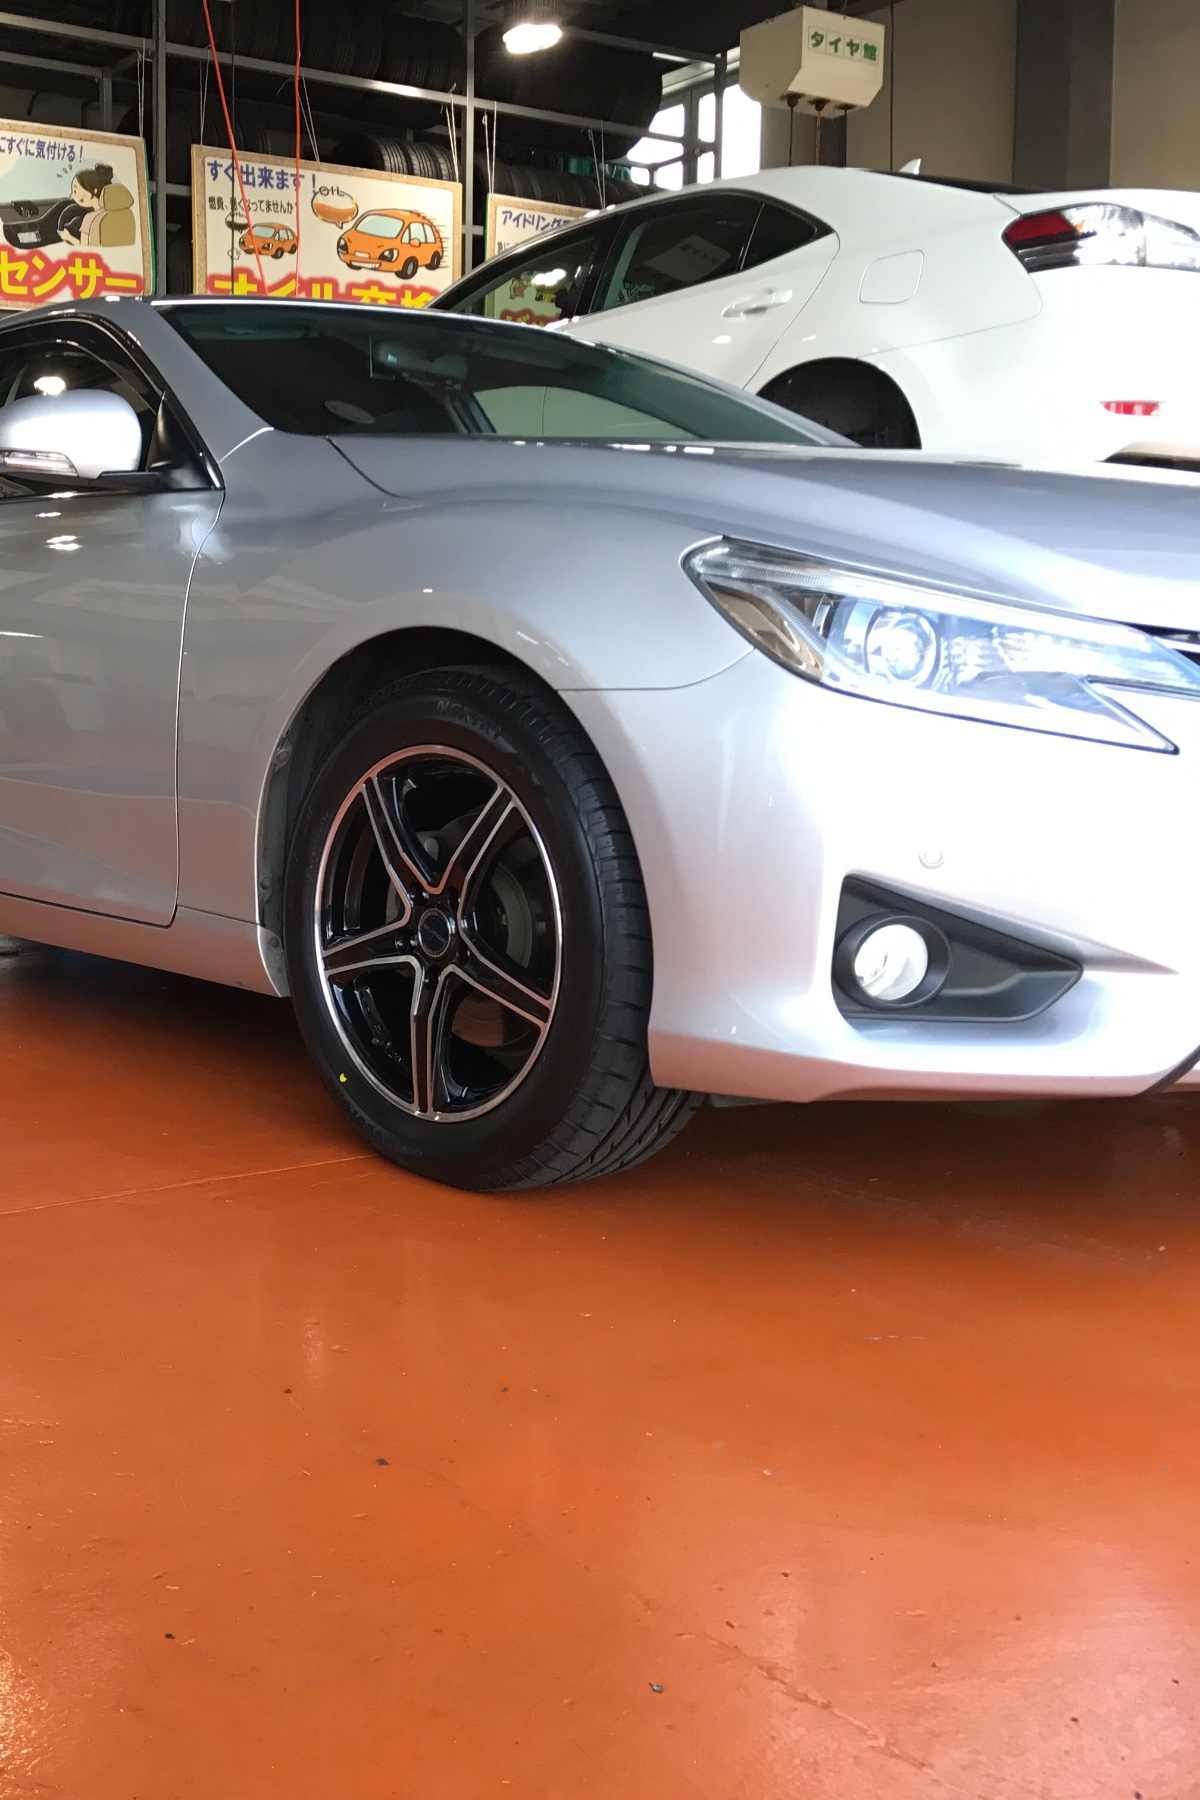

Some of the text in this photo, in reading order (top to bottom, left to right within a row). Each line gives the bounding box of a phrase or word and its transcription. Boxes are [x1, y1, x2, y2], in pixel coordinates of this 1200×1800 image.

[810, 31, 877, 61] タイヤ館
[502, 210, 571, 232] アイドリング
